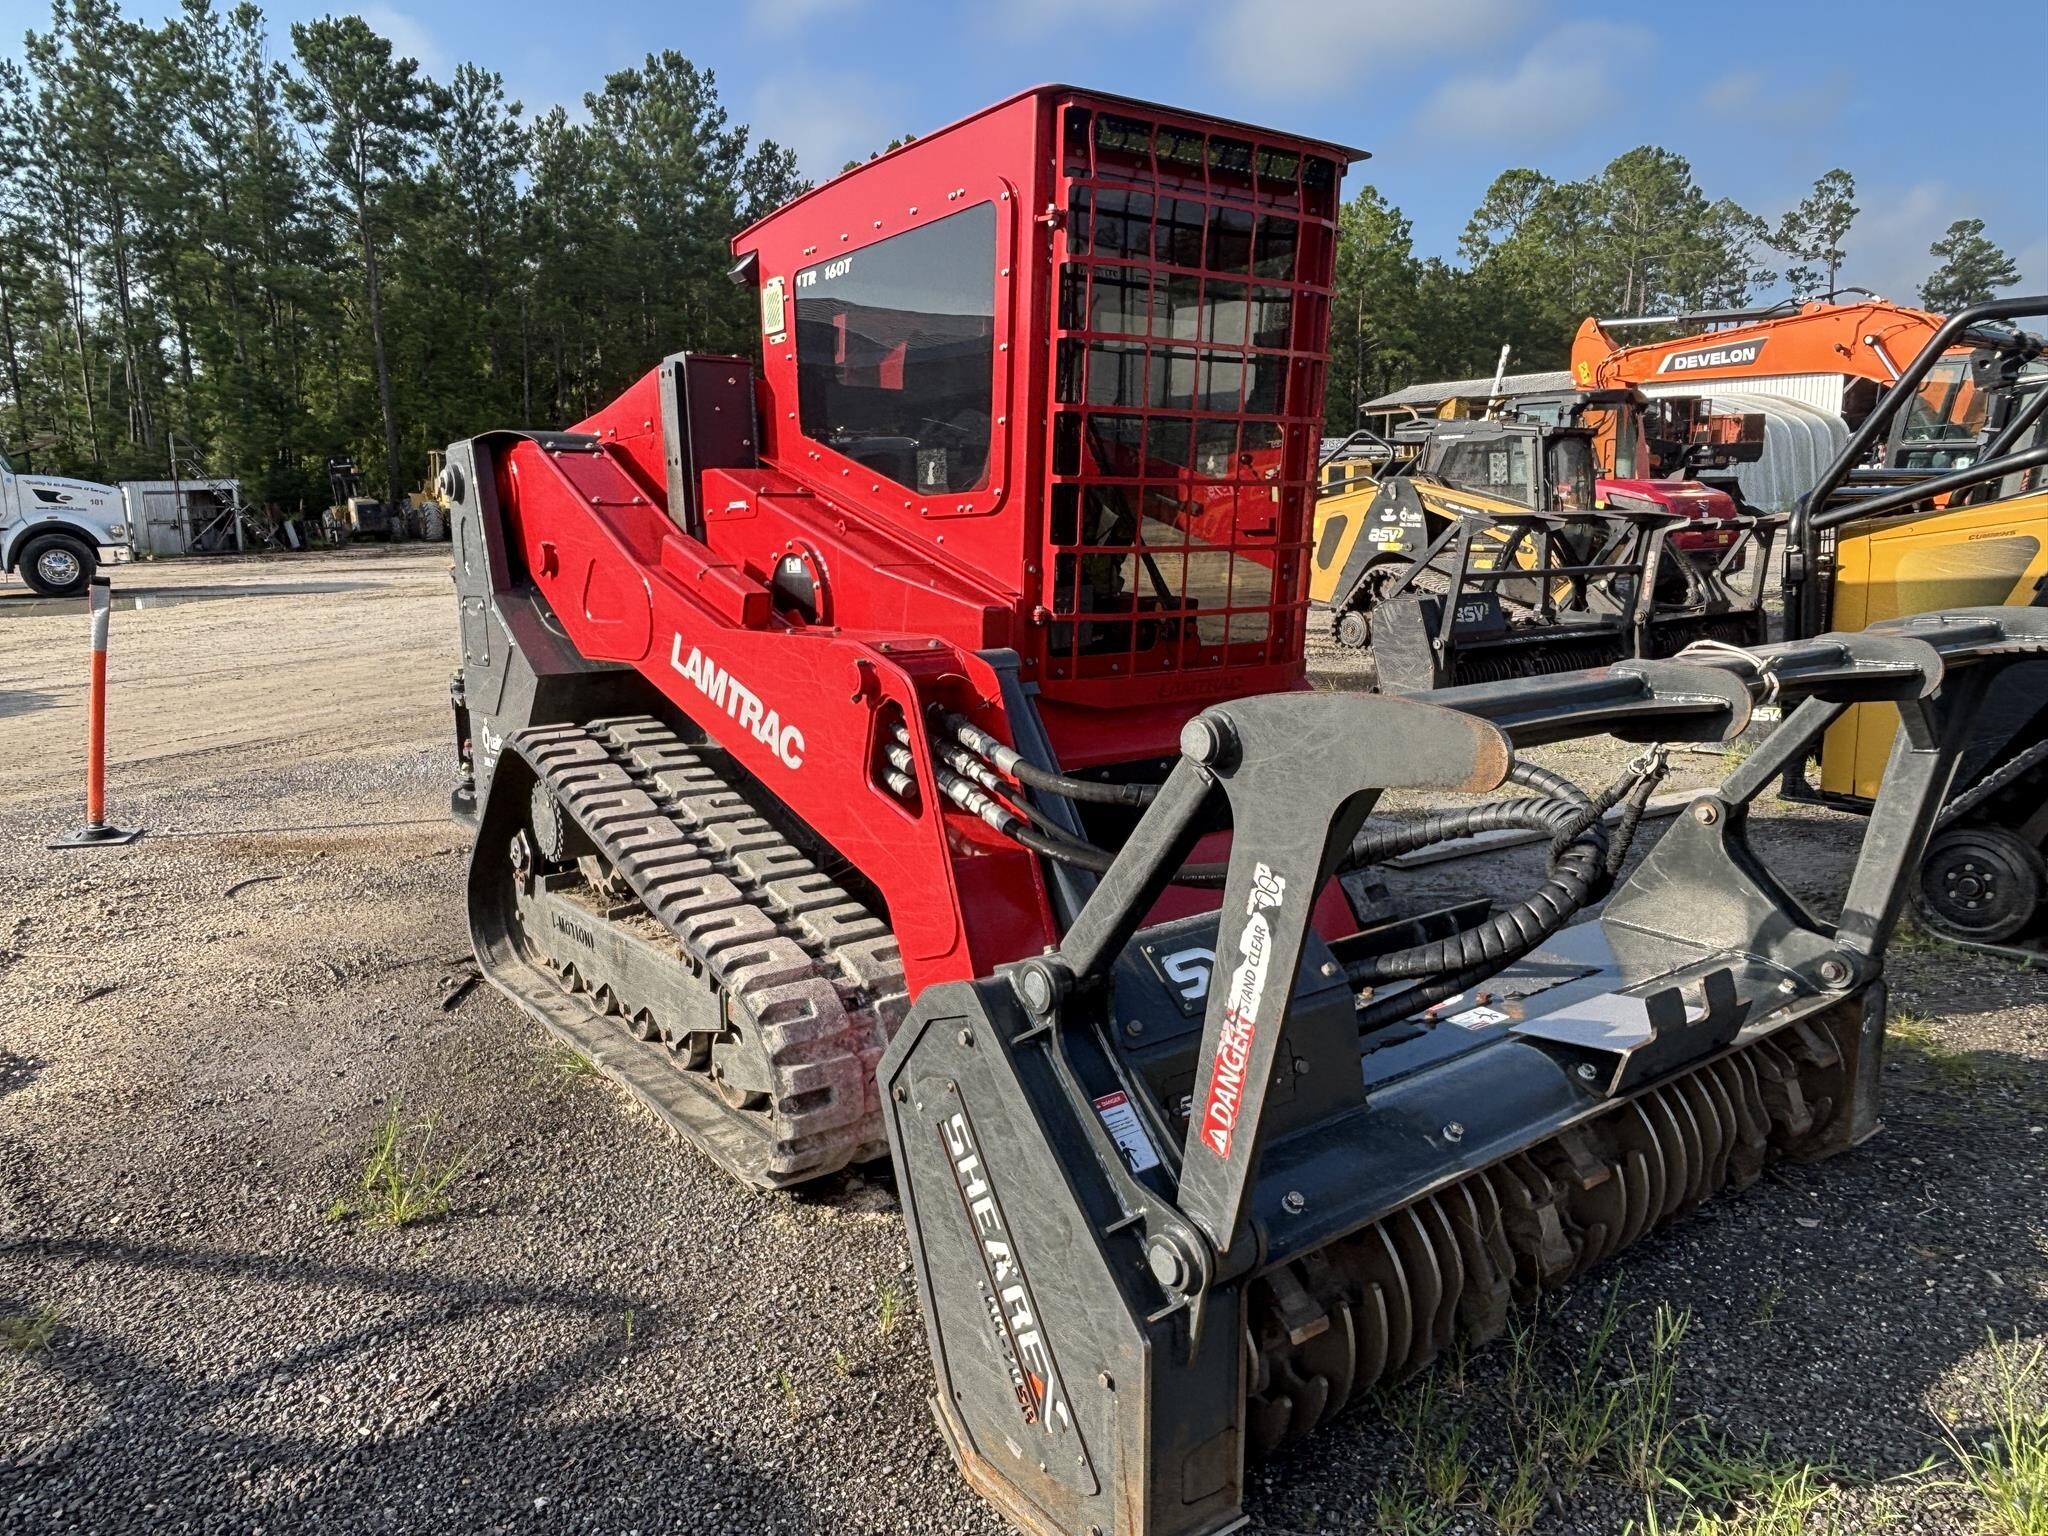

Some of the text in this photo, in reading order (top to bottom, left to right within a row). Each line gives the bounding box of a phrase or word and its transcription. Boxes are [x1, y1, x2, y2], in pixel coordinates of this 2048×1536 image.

[824, 257, 853, 280] 160T
[1674, 347, 1756, 370] DEVELON
[89, 498, 104, 506] 101
[670, 631, 805, 770] LAMTRAC
[1248, 923, 1267, 968] CLEAR
[1240, 968, 1257, 1015] STAND
[943, 1112, 1069, 1435] SHEAREX
